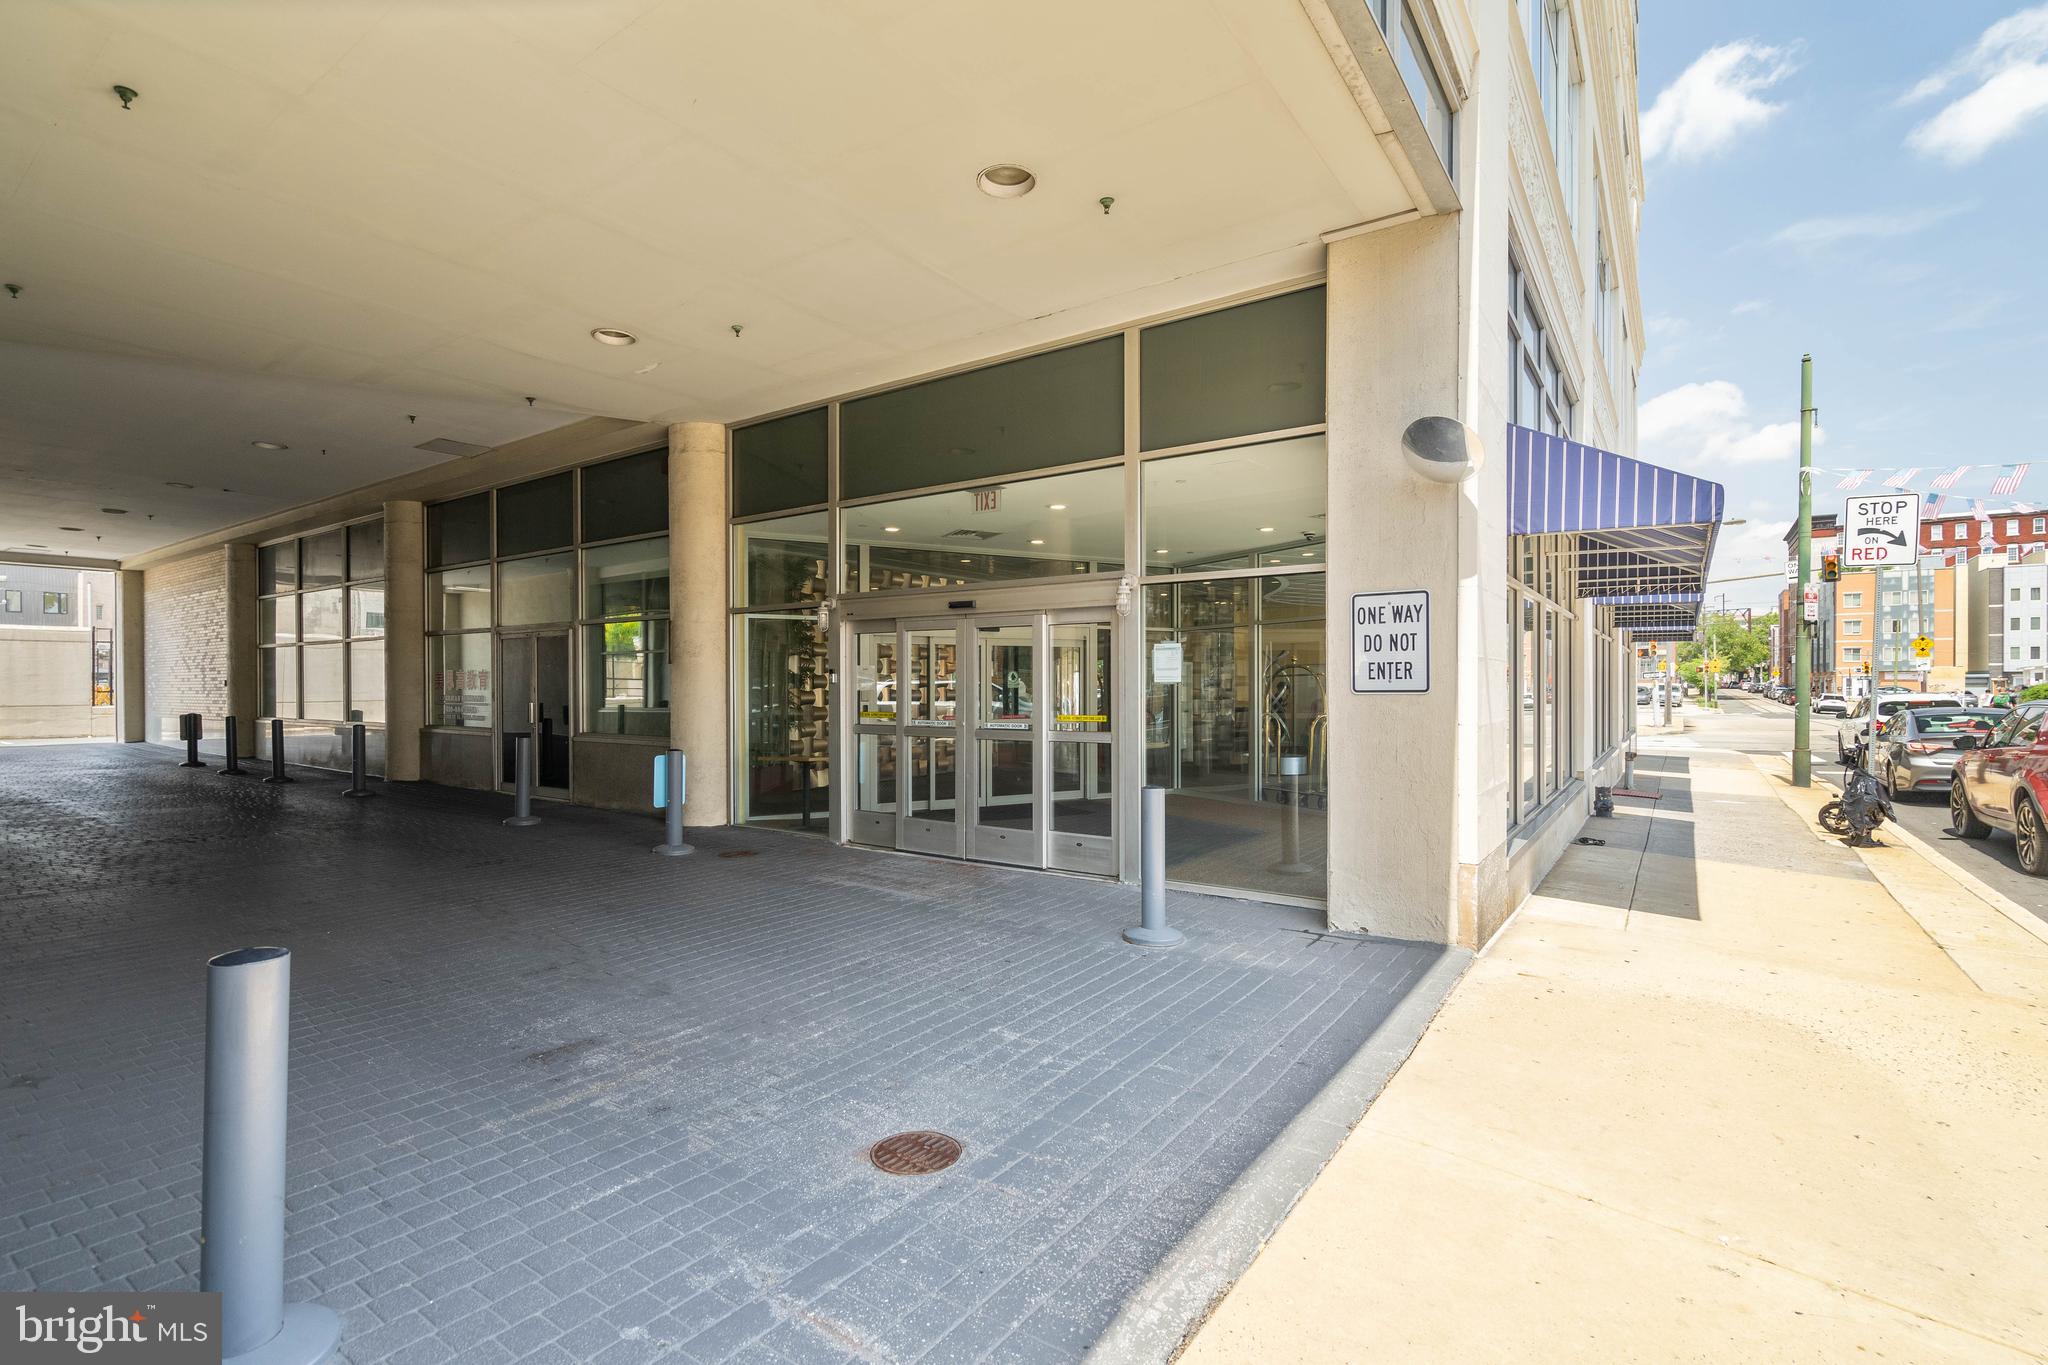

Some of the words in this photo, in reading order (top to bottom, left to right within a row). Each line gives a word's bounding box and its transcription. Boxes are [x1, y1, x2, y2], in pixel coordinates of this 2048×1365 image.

[1858, 501, 1907, 515] STOP
[1866, 516, 1898, 526] HERE
[1851, 547, 1888, 560] RED
[1357, 606, 1386, 625] ONE
[1392, 604, 1423, 623] WAY
[1364, 634, 1382, 652] DO
[1389, 633, 1417, 651] NOT
[1368, 661, 1412, 680] ENTER
